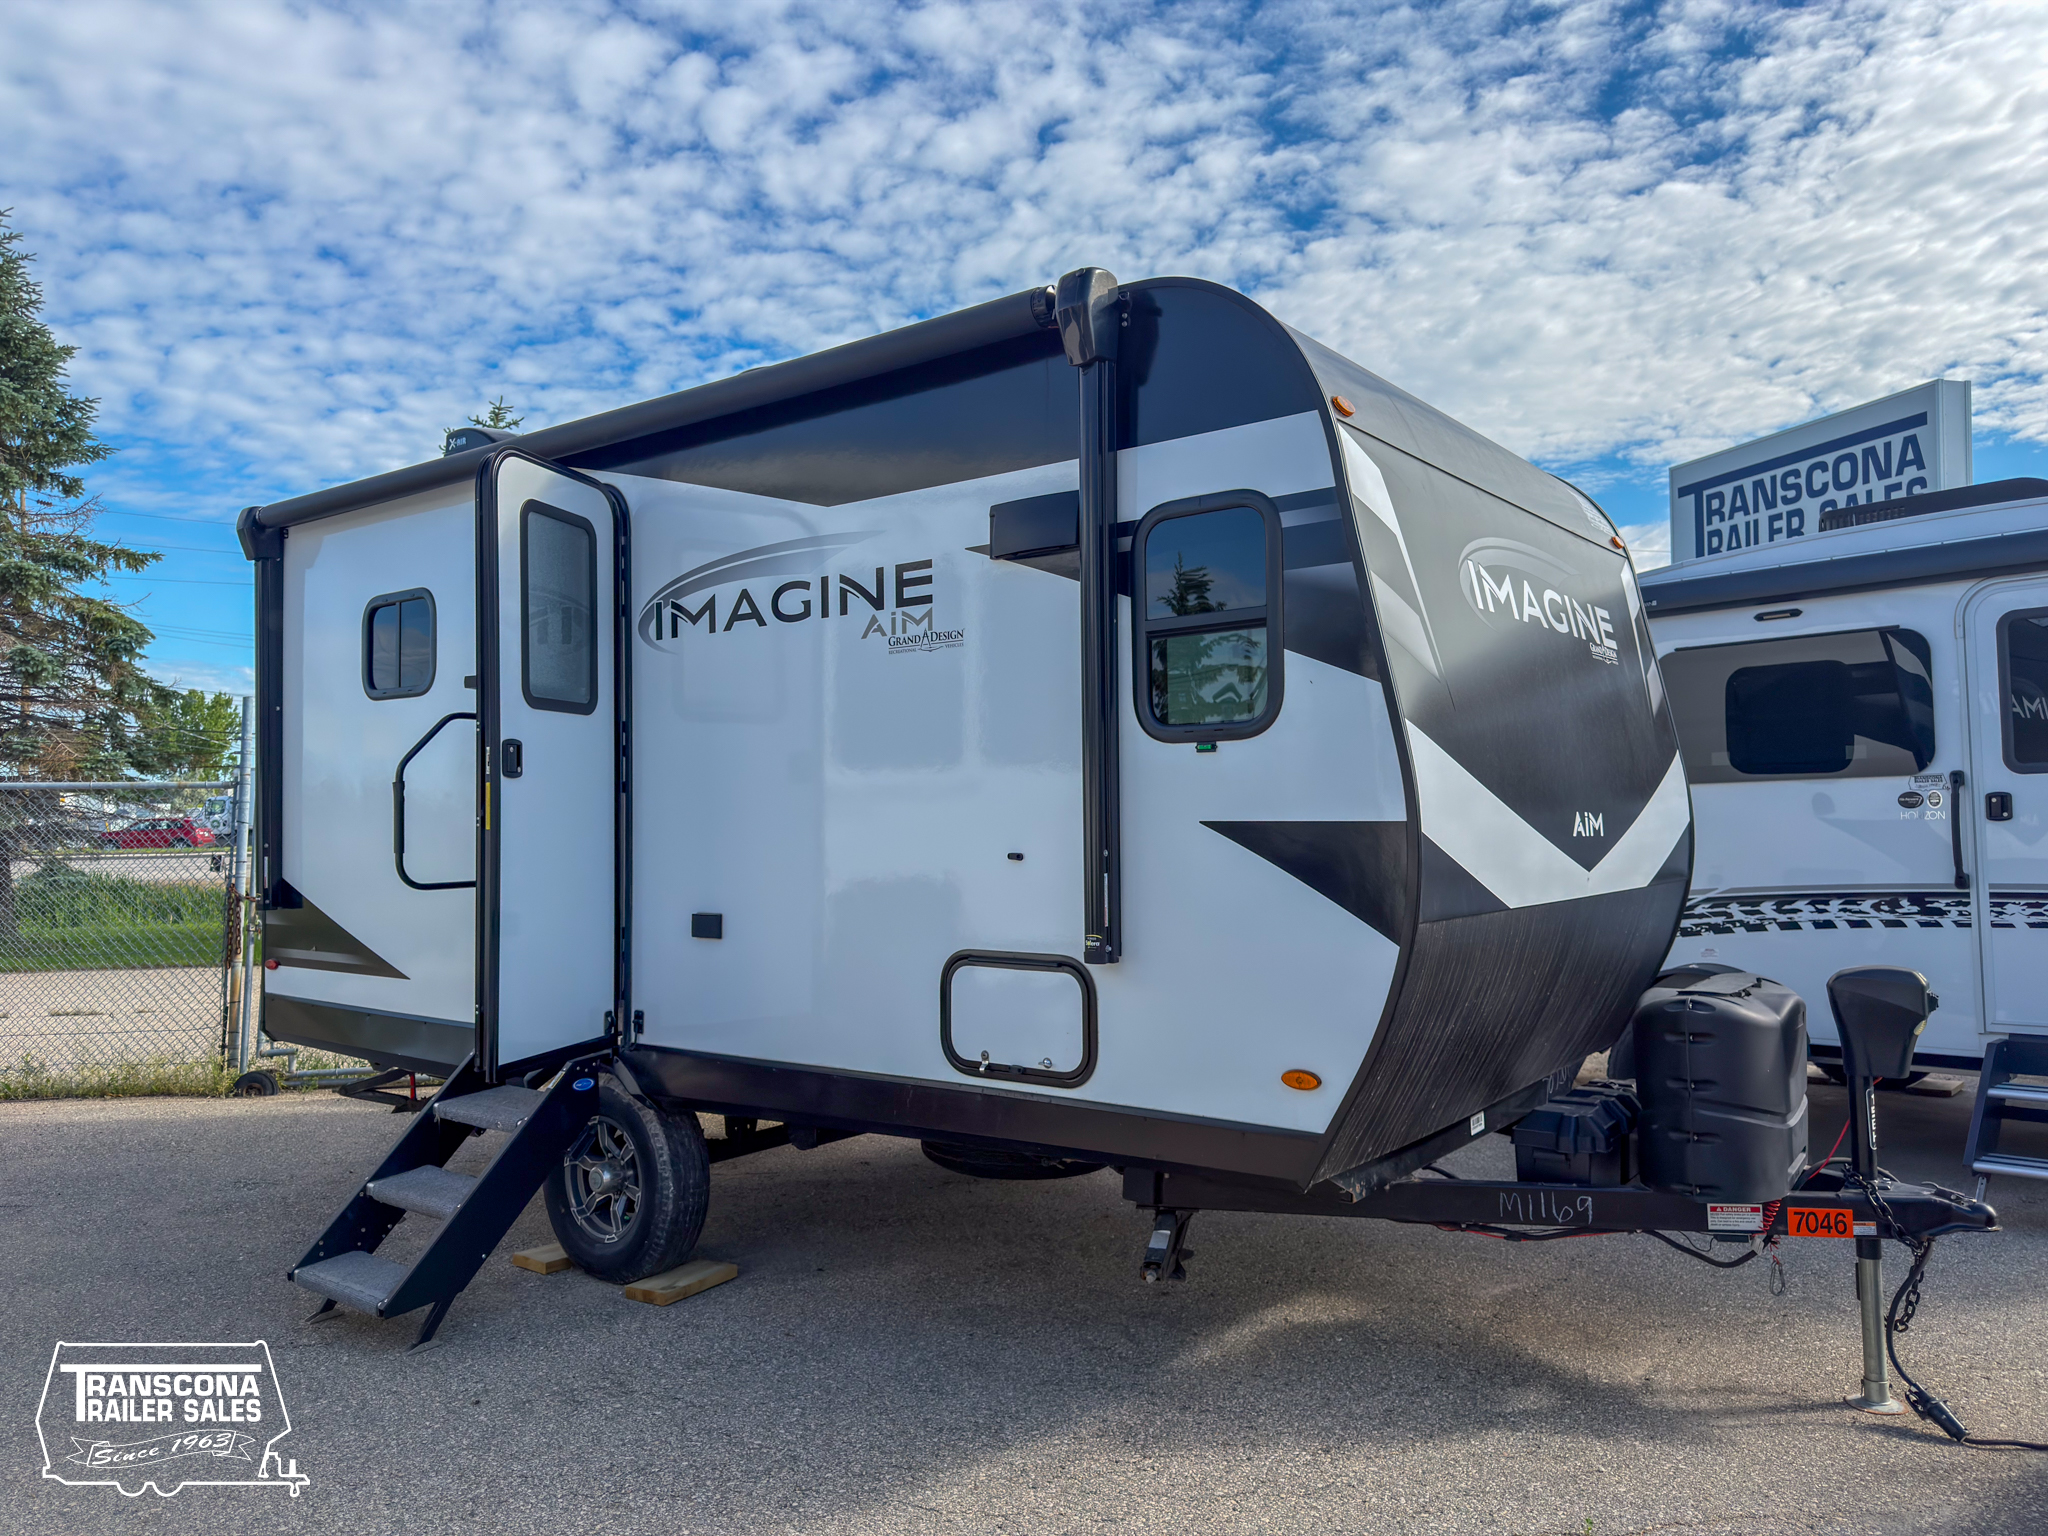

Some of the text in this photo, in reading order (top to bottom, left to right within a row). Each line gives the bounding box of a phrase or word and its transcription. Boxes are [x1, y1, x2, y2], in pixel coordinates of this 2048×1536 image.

[1678, 411, 1928, 558] TRANSCONA
[655, 558, 933, 641] IMAGINE
[888, 634, 921, 647] GRAND
[1467, 559, 1618, 650] IMAGINE
[1793, 1211, 1848, 1235] 7046
